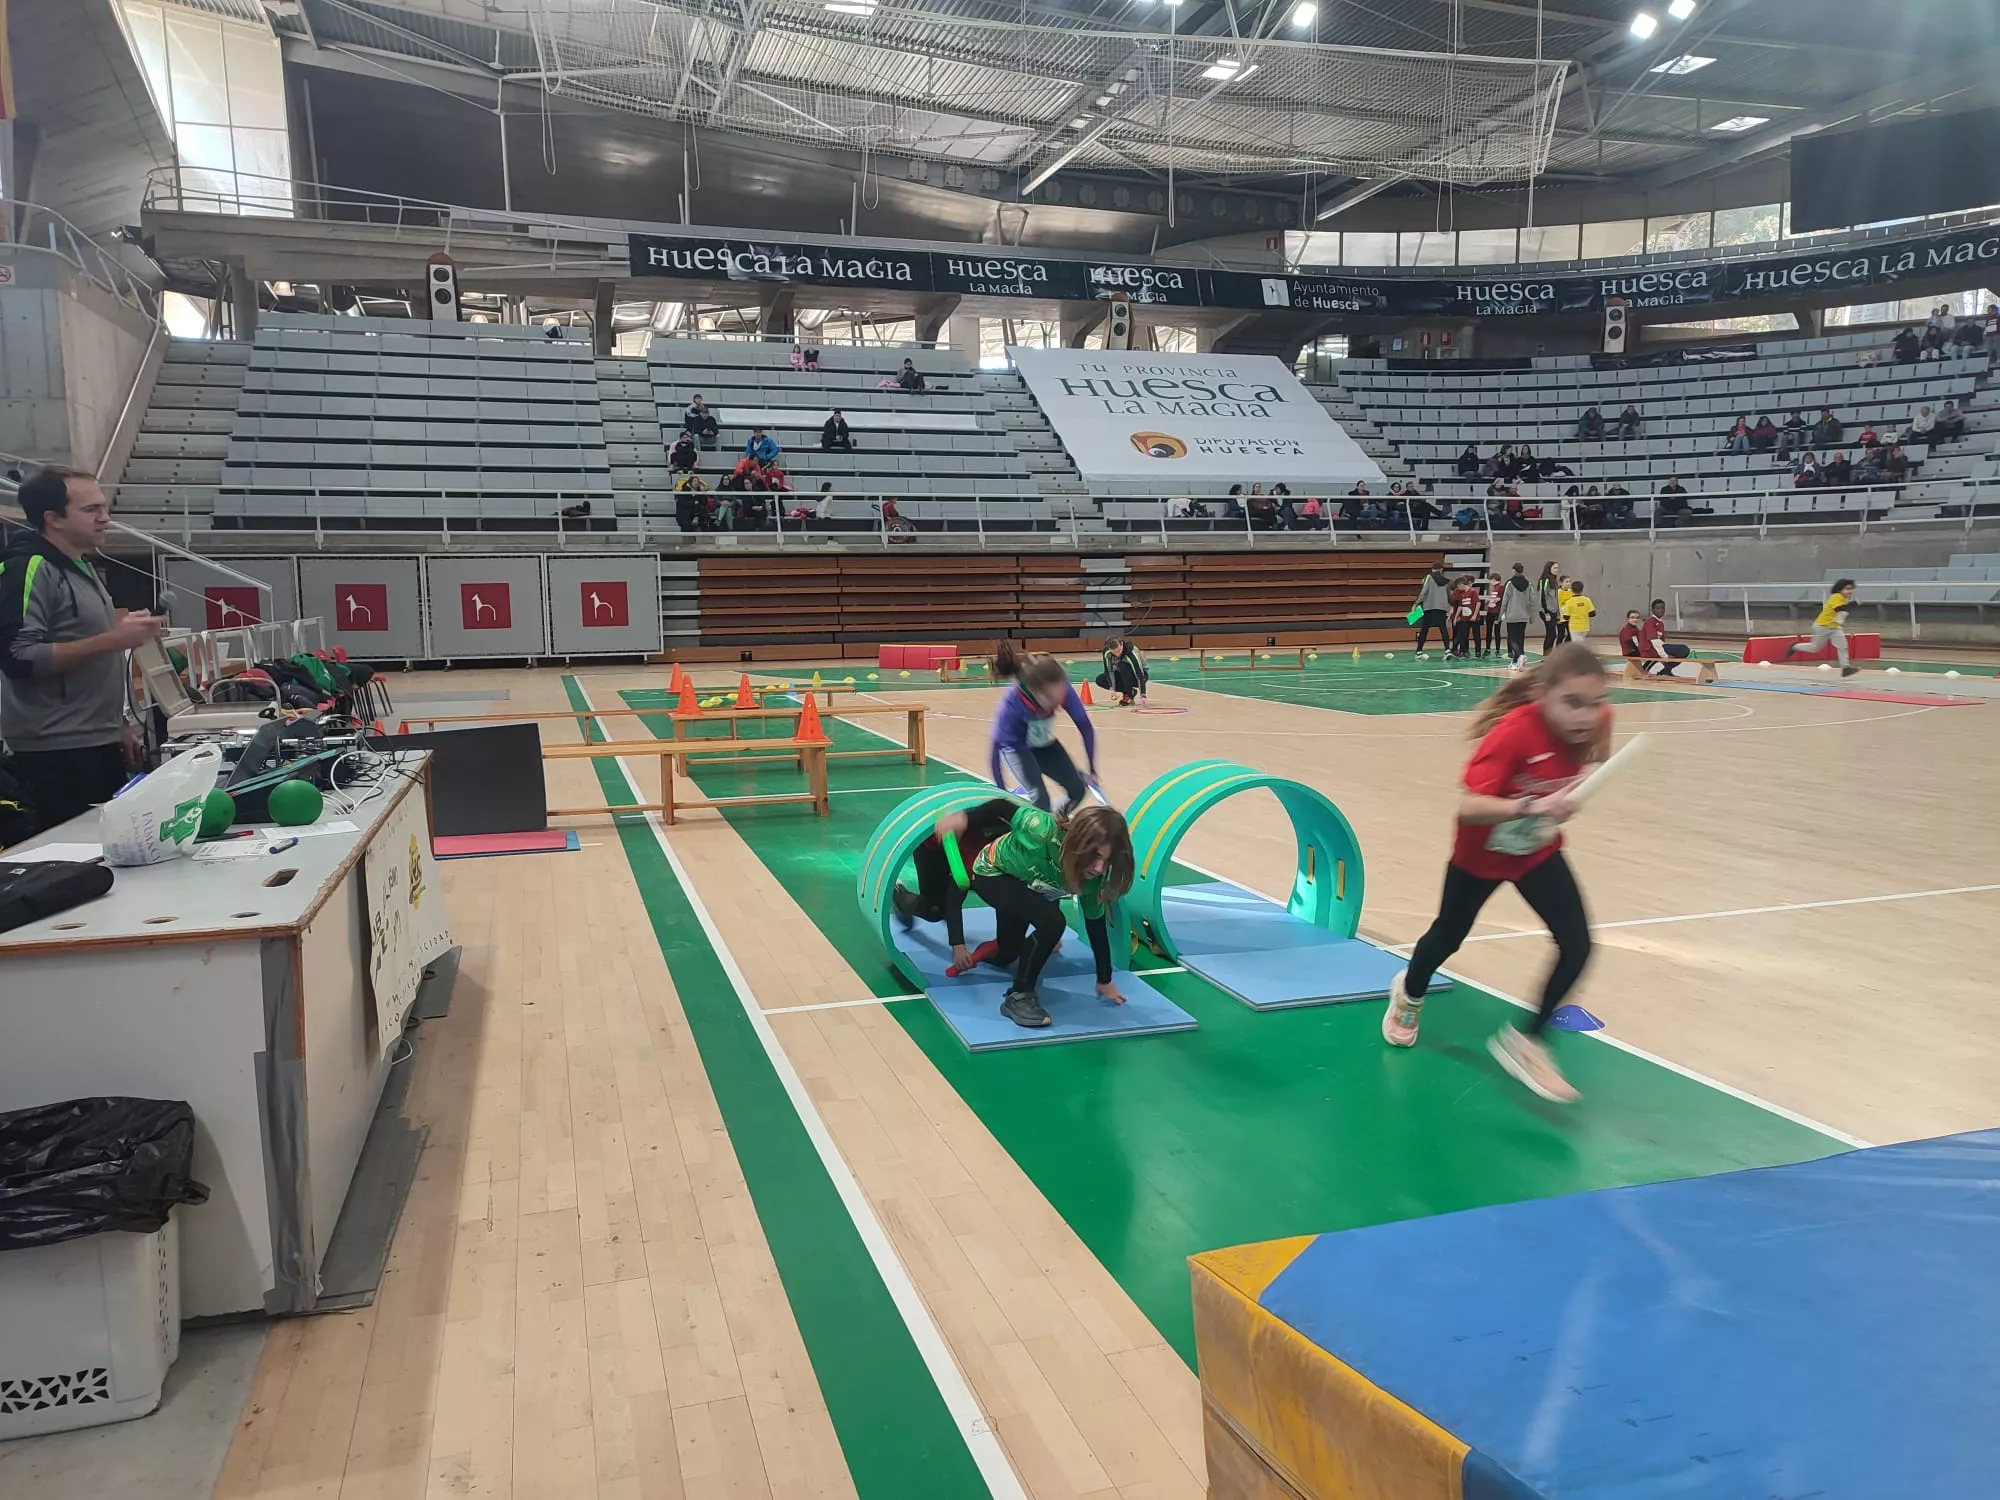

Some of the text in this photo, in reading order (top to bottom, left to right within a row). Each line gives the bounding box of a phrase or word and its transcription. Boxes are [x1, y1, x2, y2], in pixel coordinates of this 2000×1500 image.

[1293, 280, 1380, 296] Ayuntamiento
[1295, 297, 1360, 310] de Huesca
[1200, 446, 1304, 455] HUESCA
